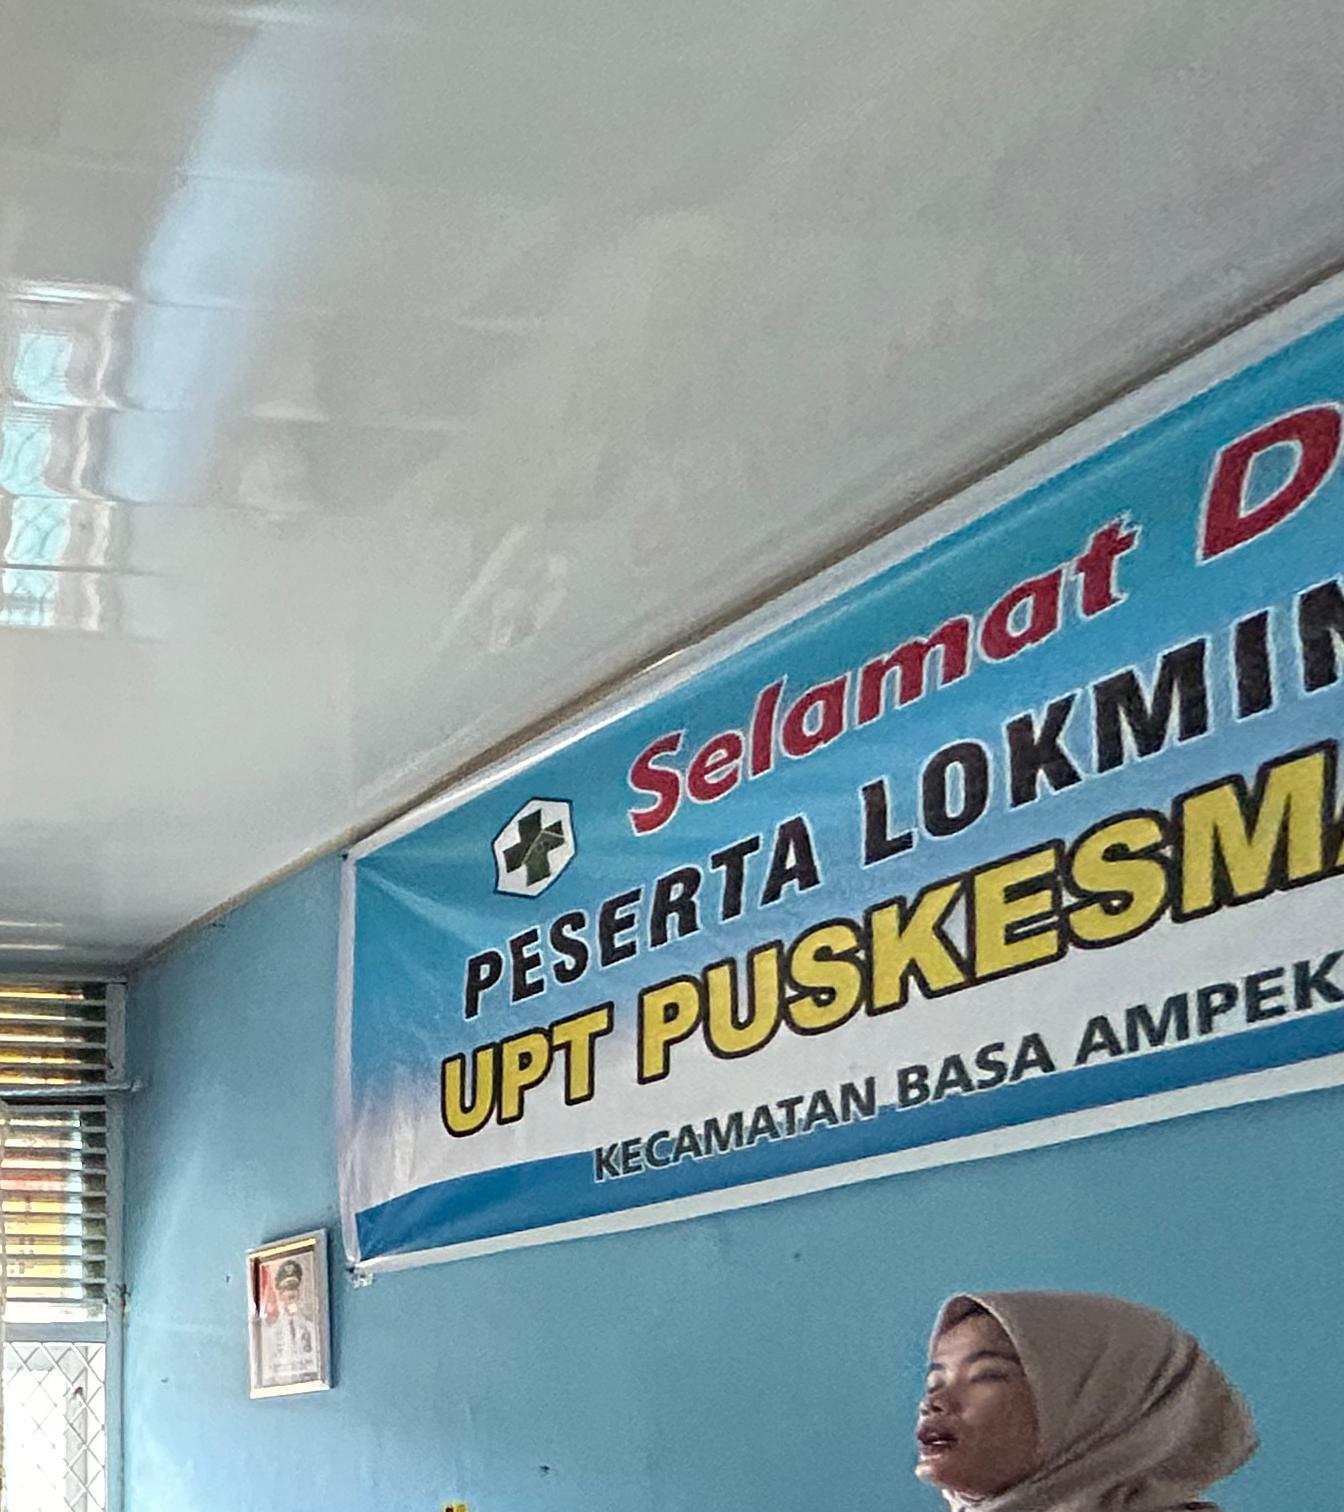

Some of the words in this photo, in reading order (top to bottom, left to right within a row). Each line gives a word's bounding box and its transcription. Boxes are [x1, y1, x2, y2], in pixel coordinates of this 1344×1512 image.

[629, 517, 1140, 834] Selamat
[440, 1002, 613, 1137] UPT
[637, 738, 1344, 1083] PUSKESM
[464, 815, 821, 1017] PESERTA
[593, 1075, 877, 1180] KECAMATAN
[896, 1033, 1056, 1111] BASA
[1073, 949, 1344, 1068] AMPEK
